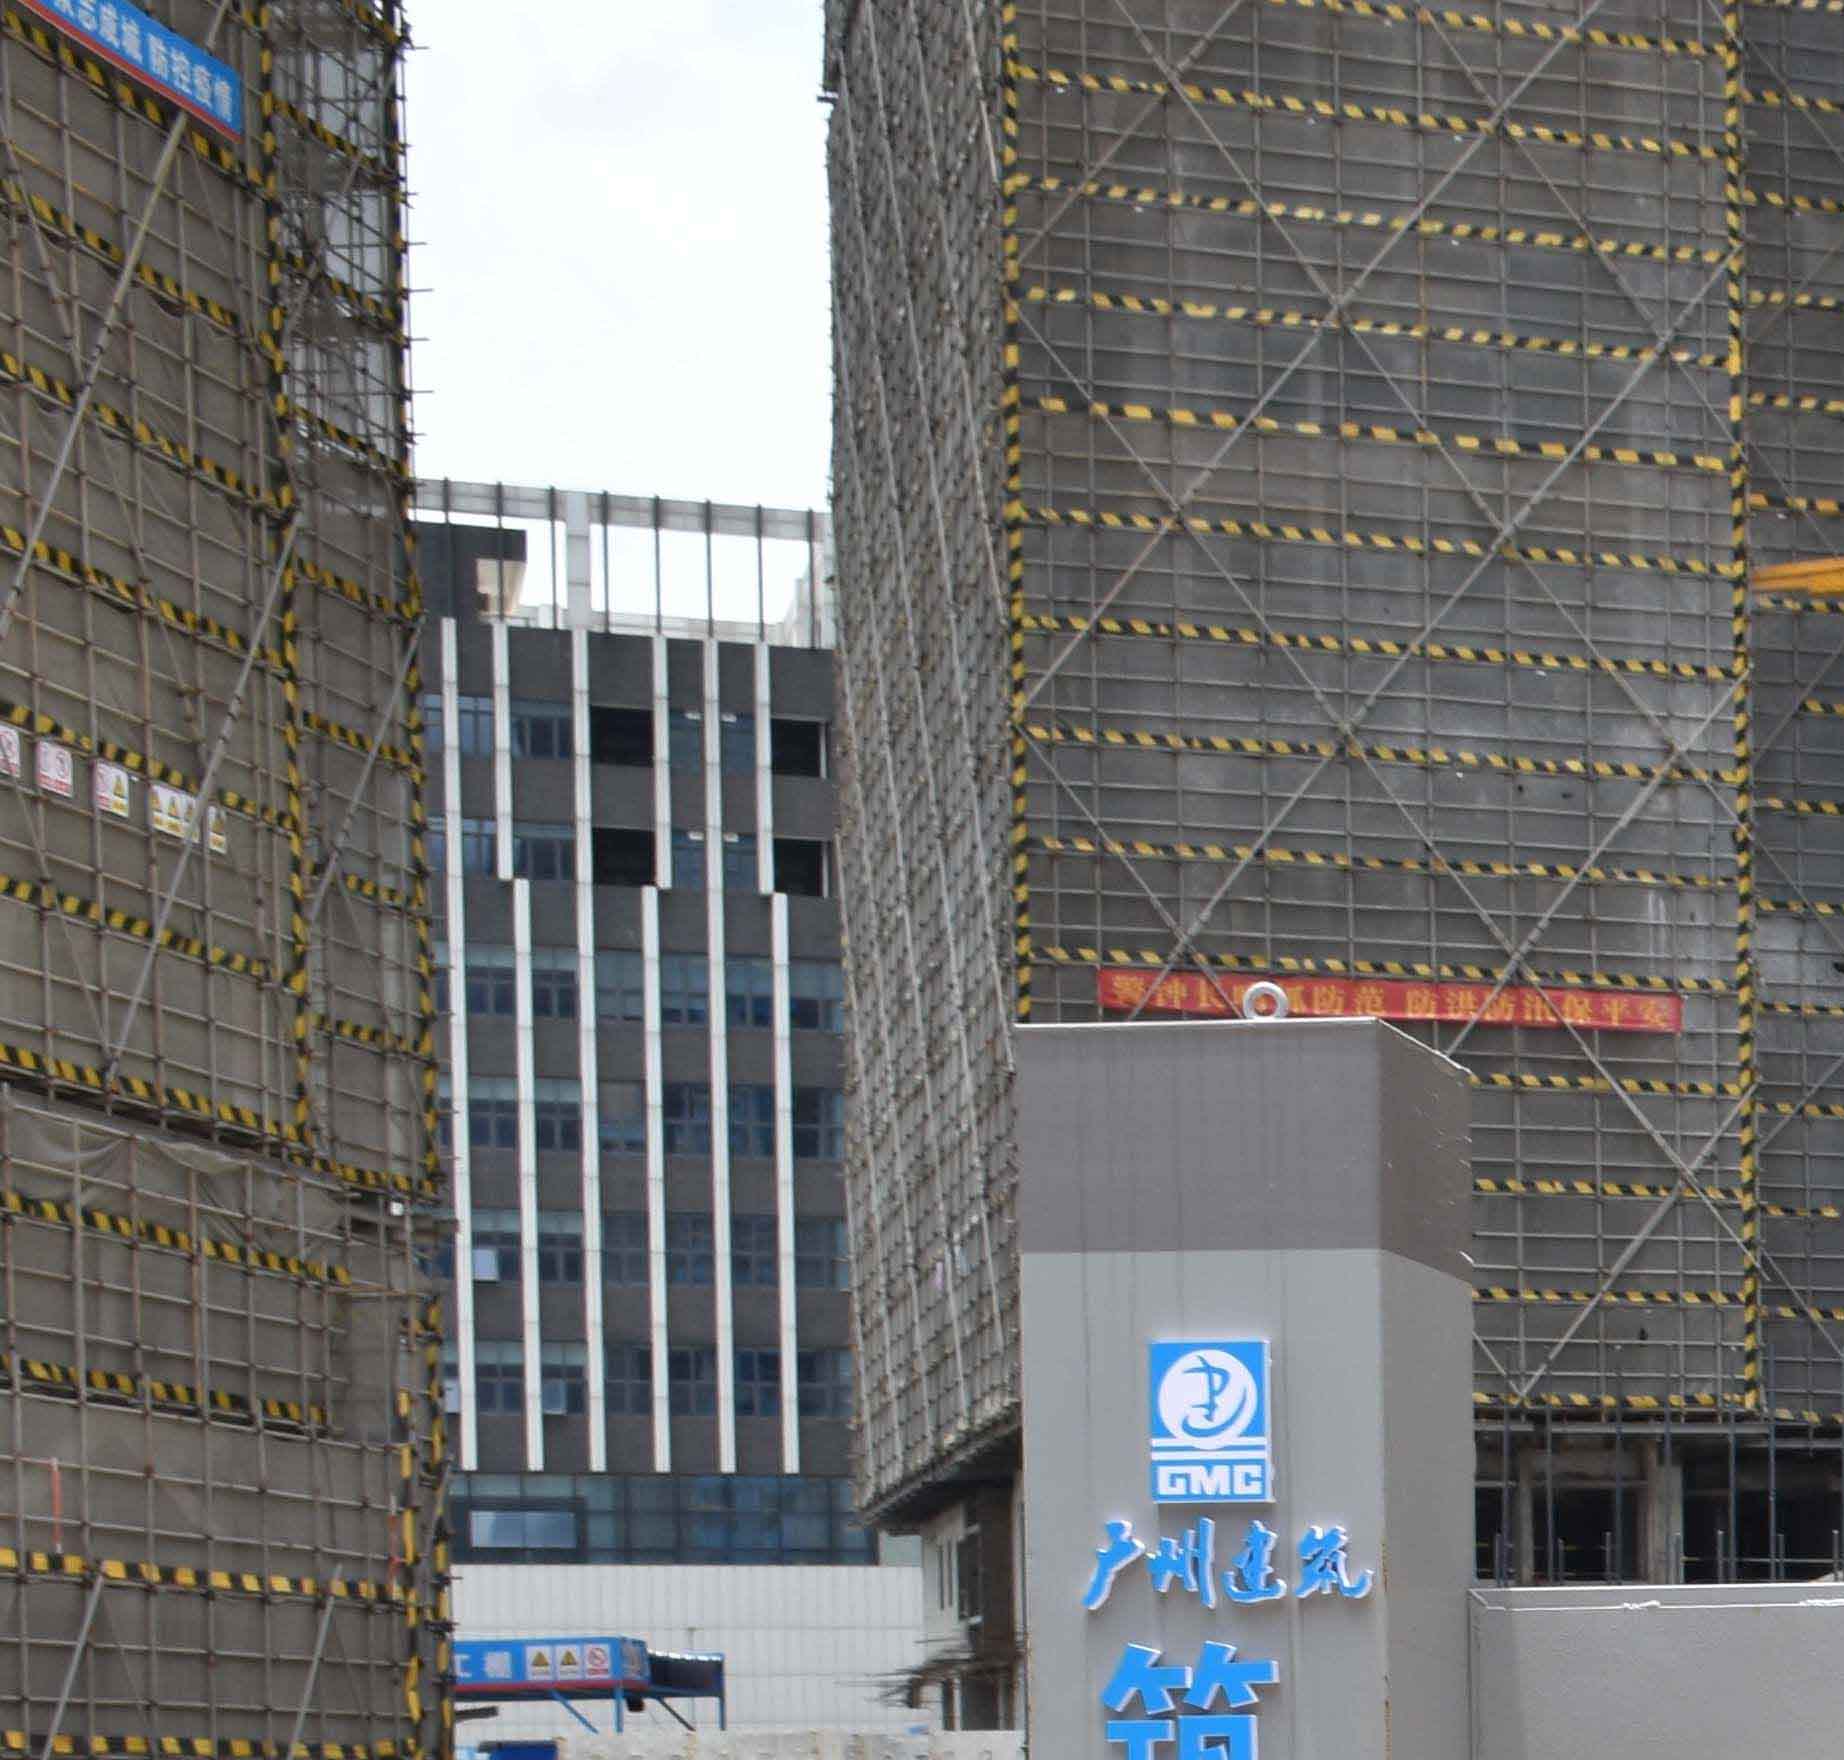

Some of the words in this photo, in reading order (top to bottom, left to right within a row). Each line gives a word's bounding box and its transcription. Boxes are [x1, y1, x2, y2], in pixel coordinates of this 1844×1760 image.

[1157, 1464, 1262, 1496] GMC
[1082, 1515, 1375, 1611] 广州建筑
